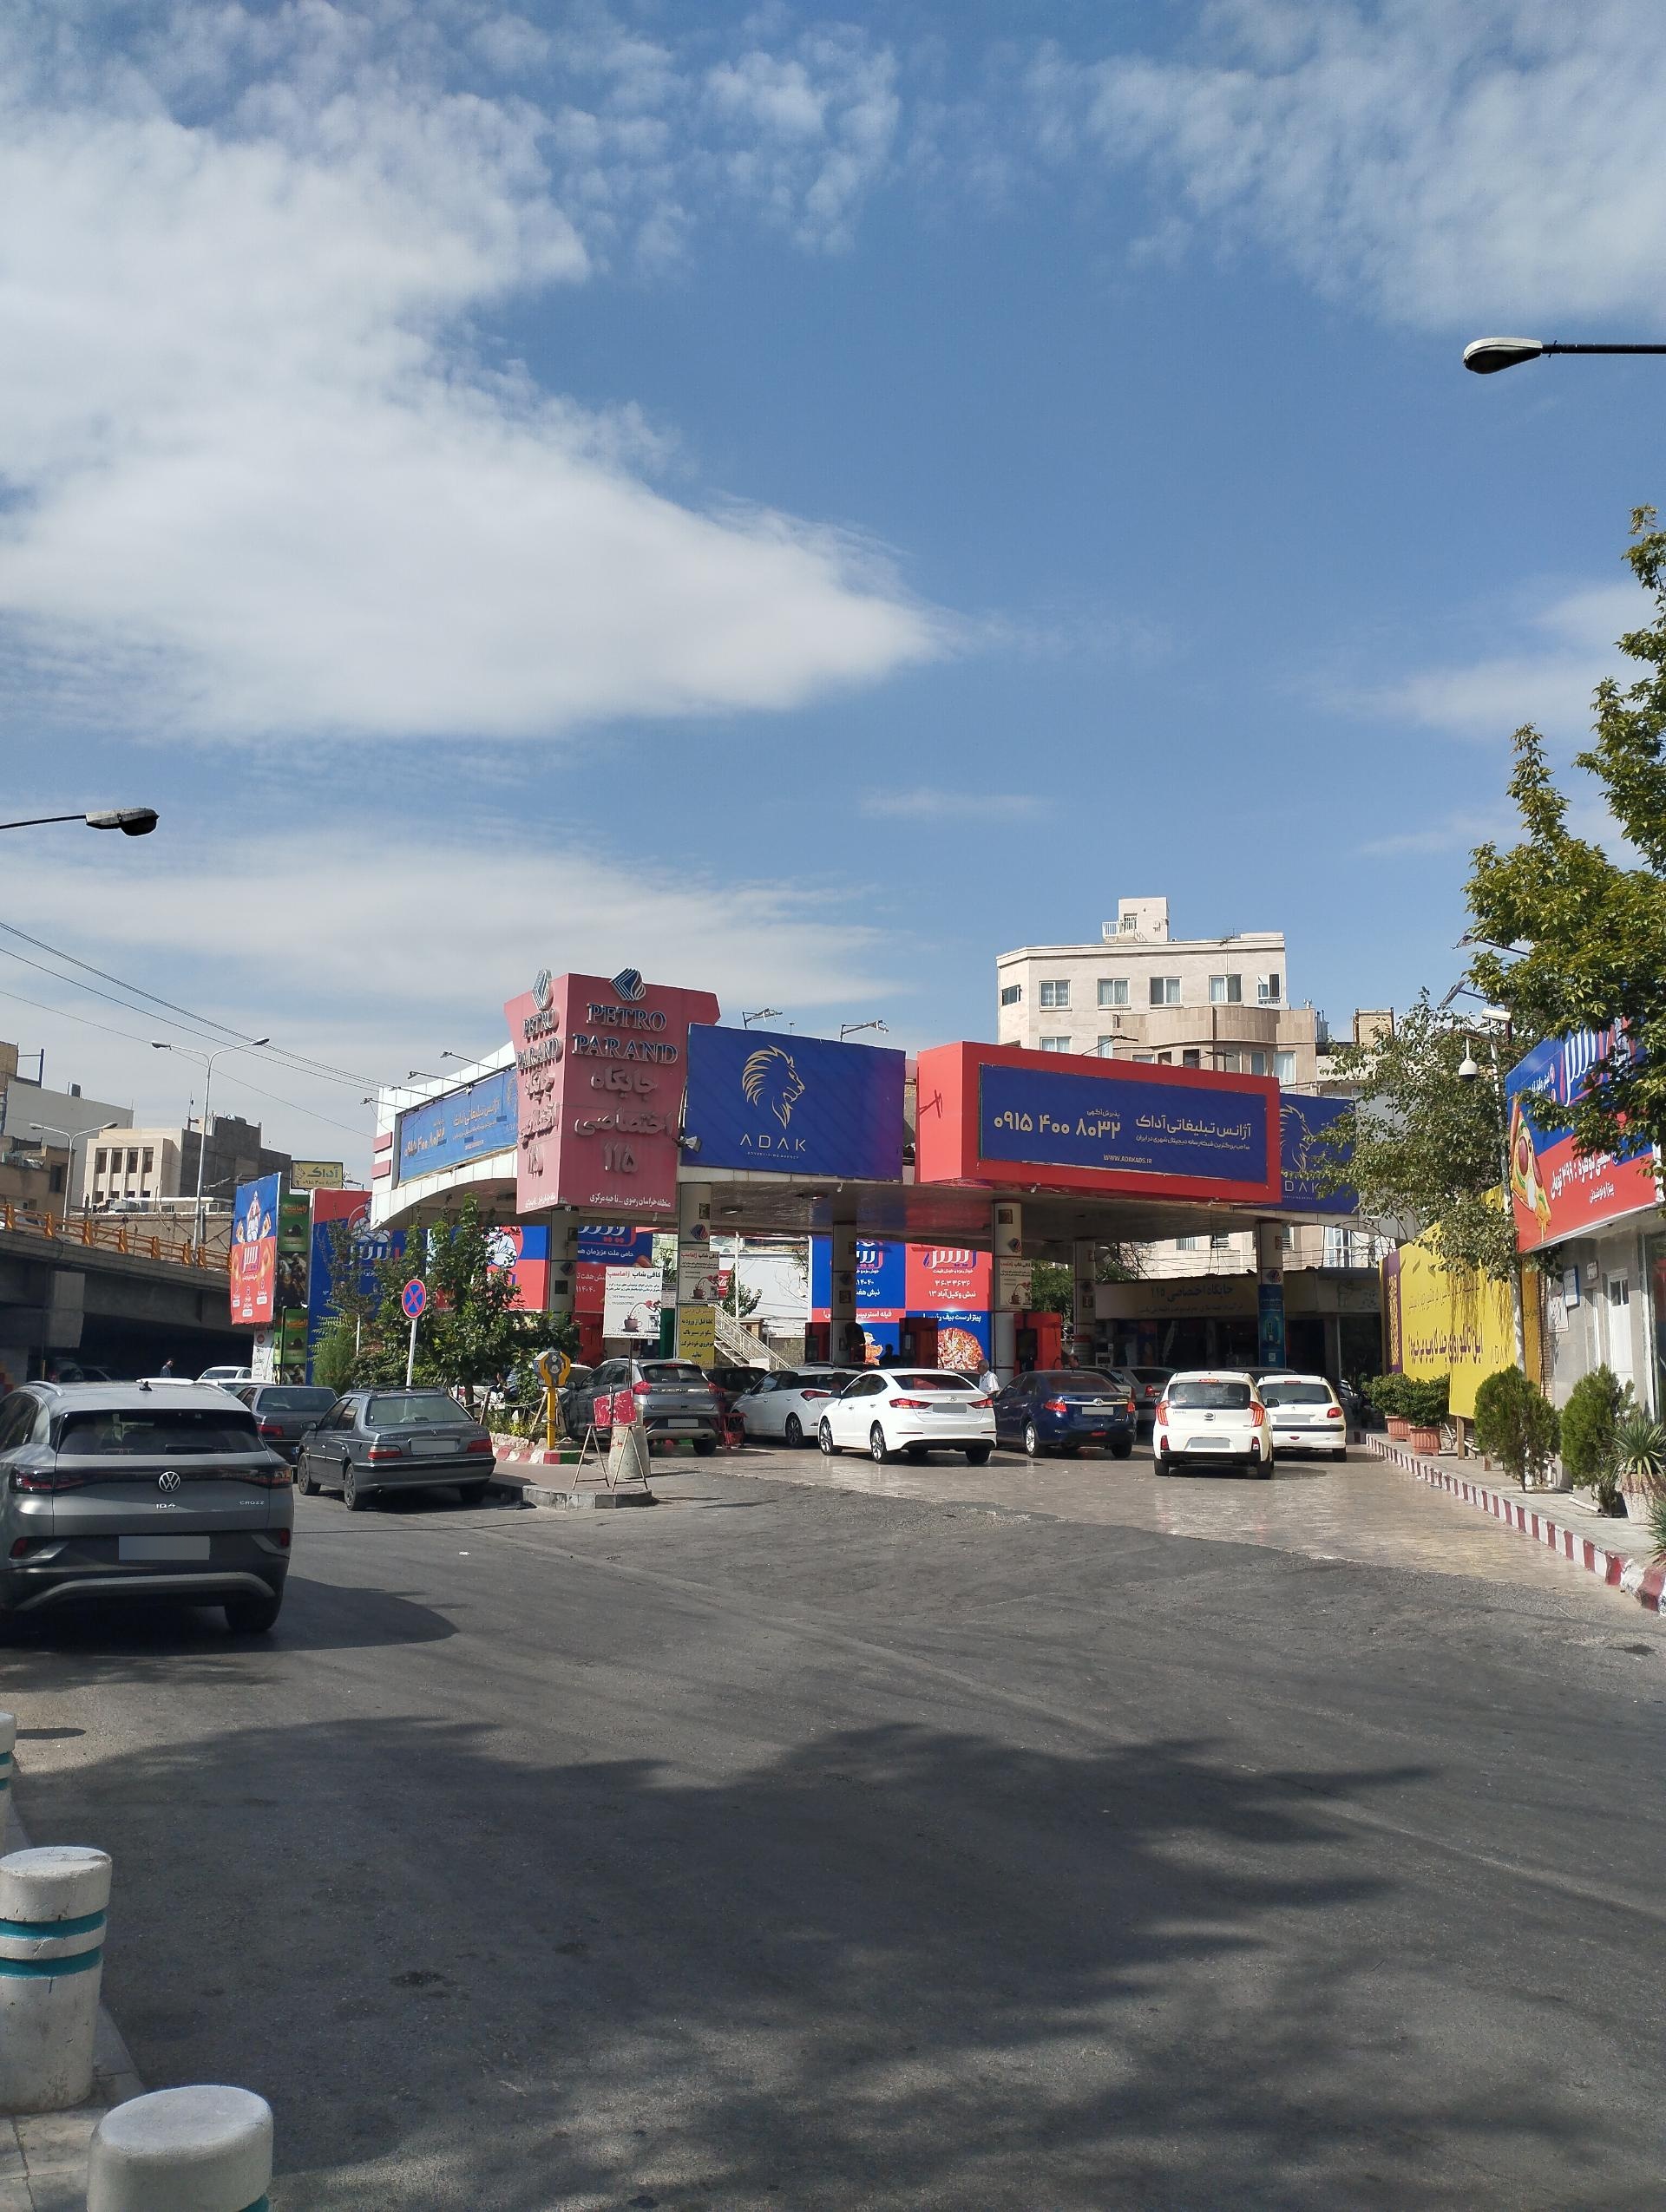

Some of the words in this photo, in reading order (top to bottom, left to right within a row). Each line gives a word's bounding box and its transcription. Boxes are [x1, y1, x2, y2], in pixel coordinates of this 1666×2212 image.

[523, 1009, 558, 1038] PETRO
[586, 1003, 666, 1032] PETRO
[516, 1038, 561, 1071] PARAND
[572, 1033, 679, 1064] PARAND
[591, 1066, 659, 1102] جایگاه
[574, 1107, 672, 1136] اختصاصی
[1102, 1110, 1121, 1119] پذیرش
[1136, 1115, 1166, 1129] آداک
[994, 1111, 1033, 1132] ۰۹۱۵
[1040, 1115, 1070, 1133] ۴۰۰
[1076, 1118, 1121, 1139] ۸۰۳۲
[1167, 1118, 1216, 1136] تبلیغاتی
[1217, 1123, 1251, 1140] آژانس
[739, 1134, 805, 1151] ADAK
[605, 1143, 638, 1172] ۱۱۵
[1103, 1154, 1152, 1164] WWW.ADAKADS.IR
[307, 1166, 338, 1178] آداک
[1285, 1181, 1320, 1193] DAK
[640, 1197, 659, 1207] خراسان
